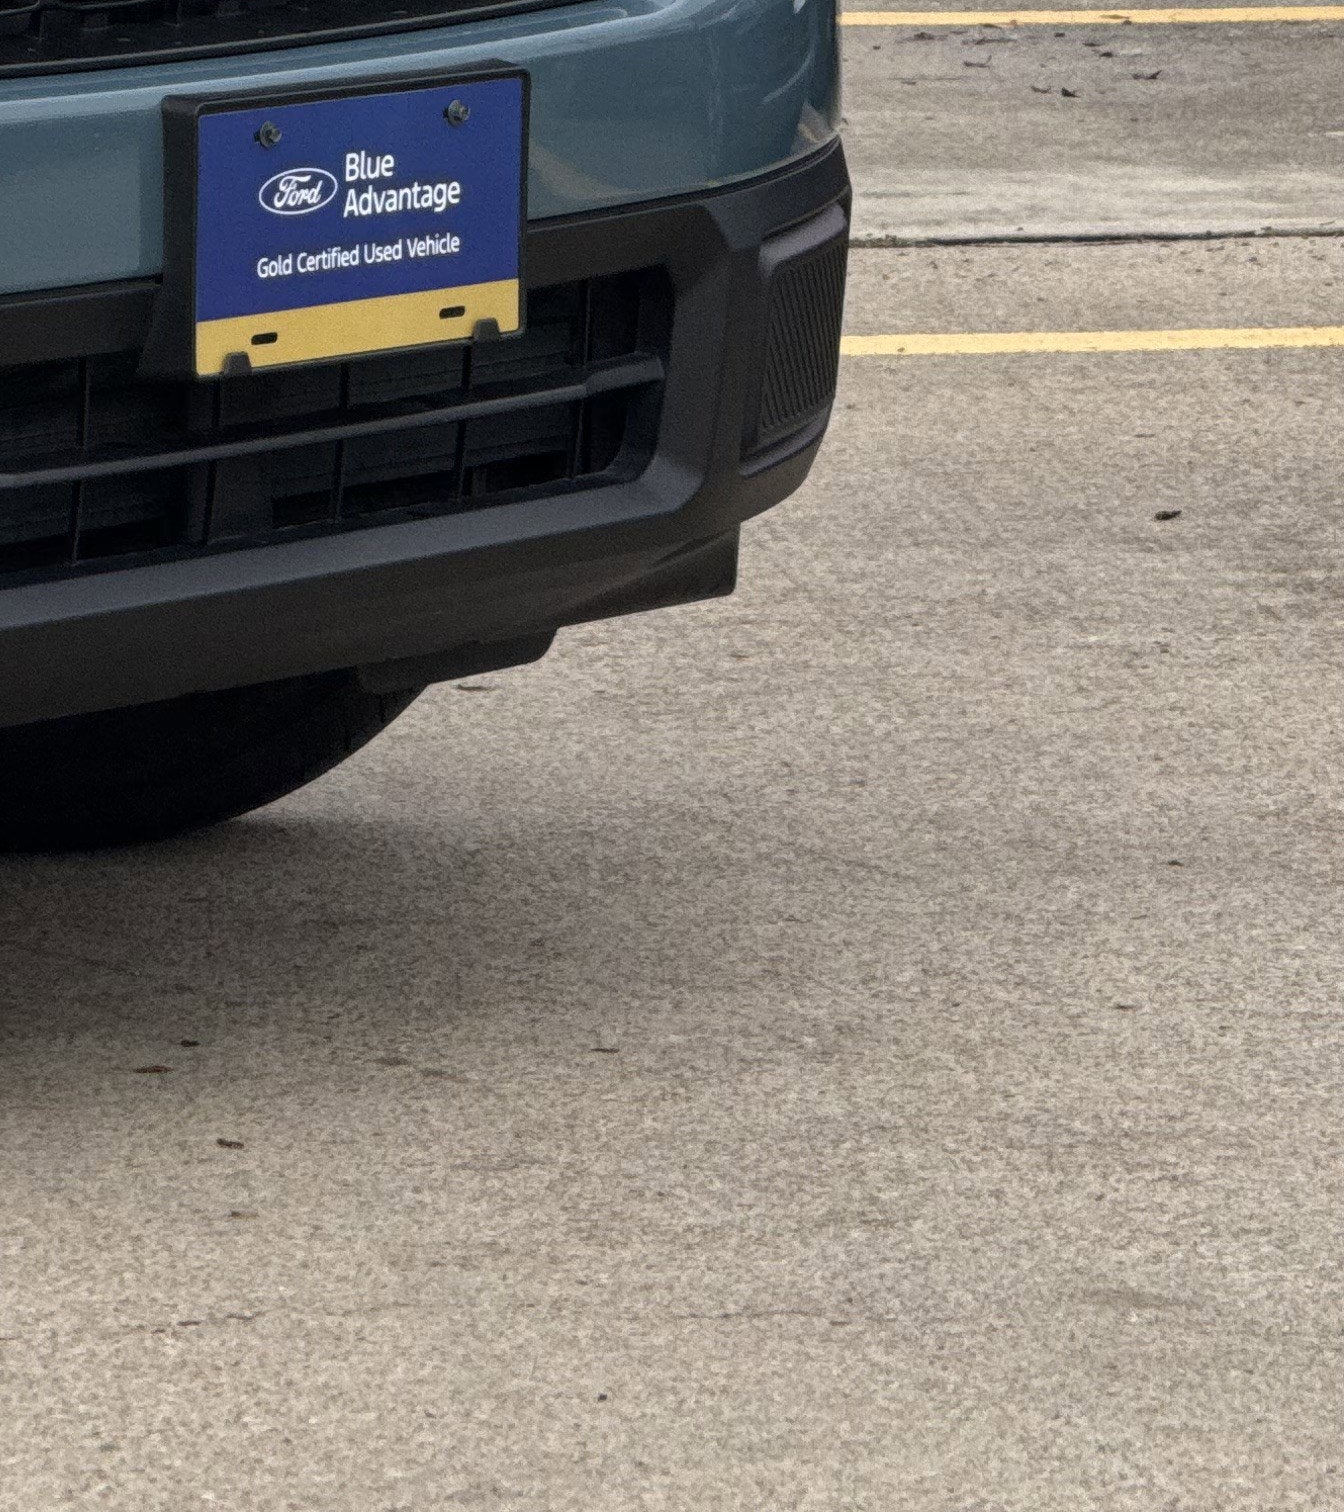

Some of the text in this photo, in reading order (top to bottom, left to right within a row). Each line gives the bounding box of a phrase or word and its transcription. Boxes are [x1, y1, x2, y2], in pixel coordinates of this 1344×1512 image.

[345, 150, 395, 182] Blue
[273, 174, 323, 208] Ford
[343, 181, 461, 218] Advantage
[257, 232, 461, 278] Gold Certified Used Vehicle
